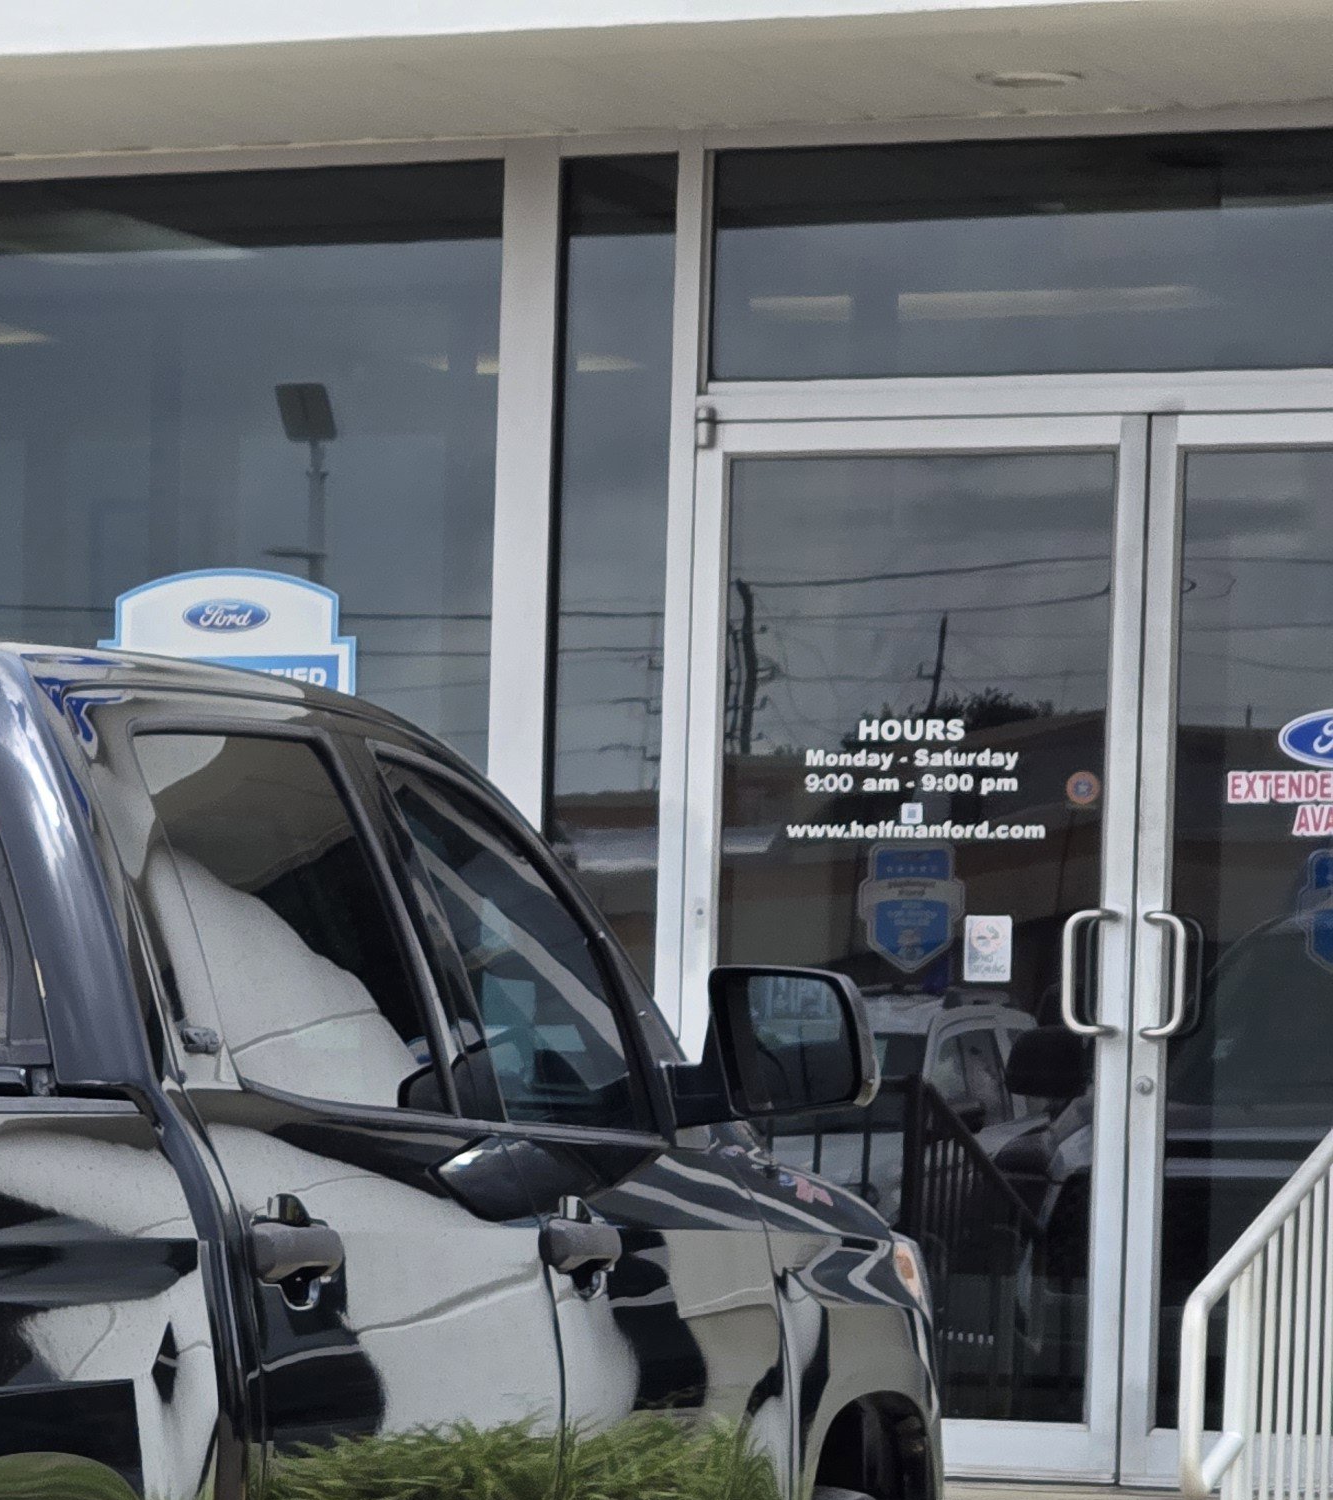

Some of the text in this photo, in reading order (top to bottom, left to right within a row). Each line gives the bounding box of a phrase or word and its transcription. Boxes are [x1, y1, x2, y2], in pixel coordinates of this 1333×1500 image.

[196, 602, 254, 630] Ford
[858, 719, 965, 741] HOURS
[805, 749, 893, 771] Monday
[914, 748, 1019, 771] Saturday
[804, 773, 854, 793] 9:00
[862, 776, 900, 792] am
[922, 773, 974, 792] 9:00
[980, 776, 1019, 796] pm
[786, 820, 1046, 840] www.helfmanford.com
